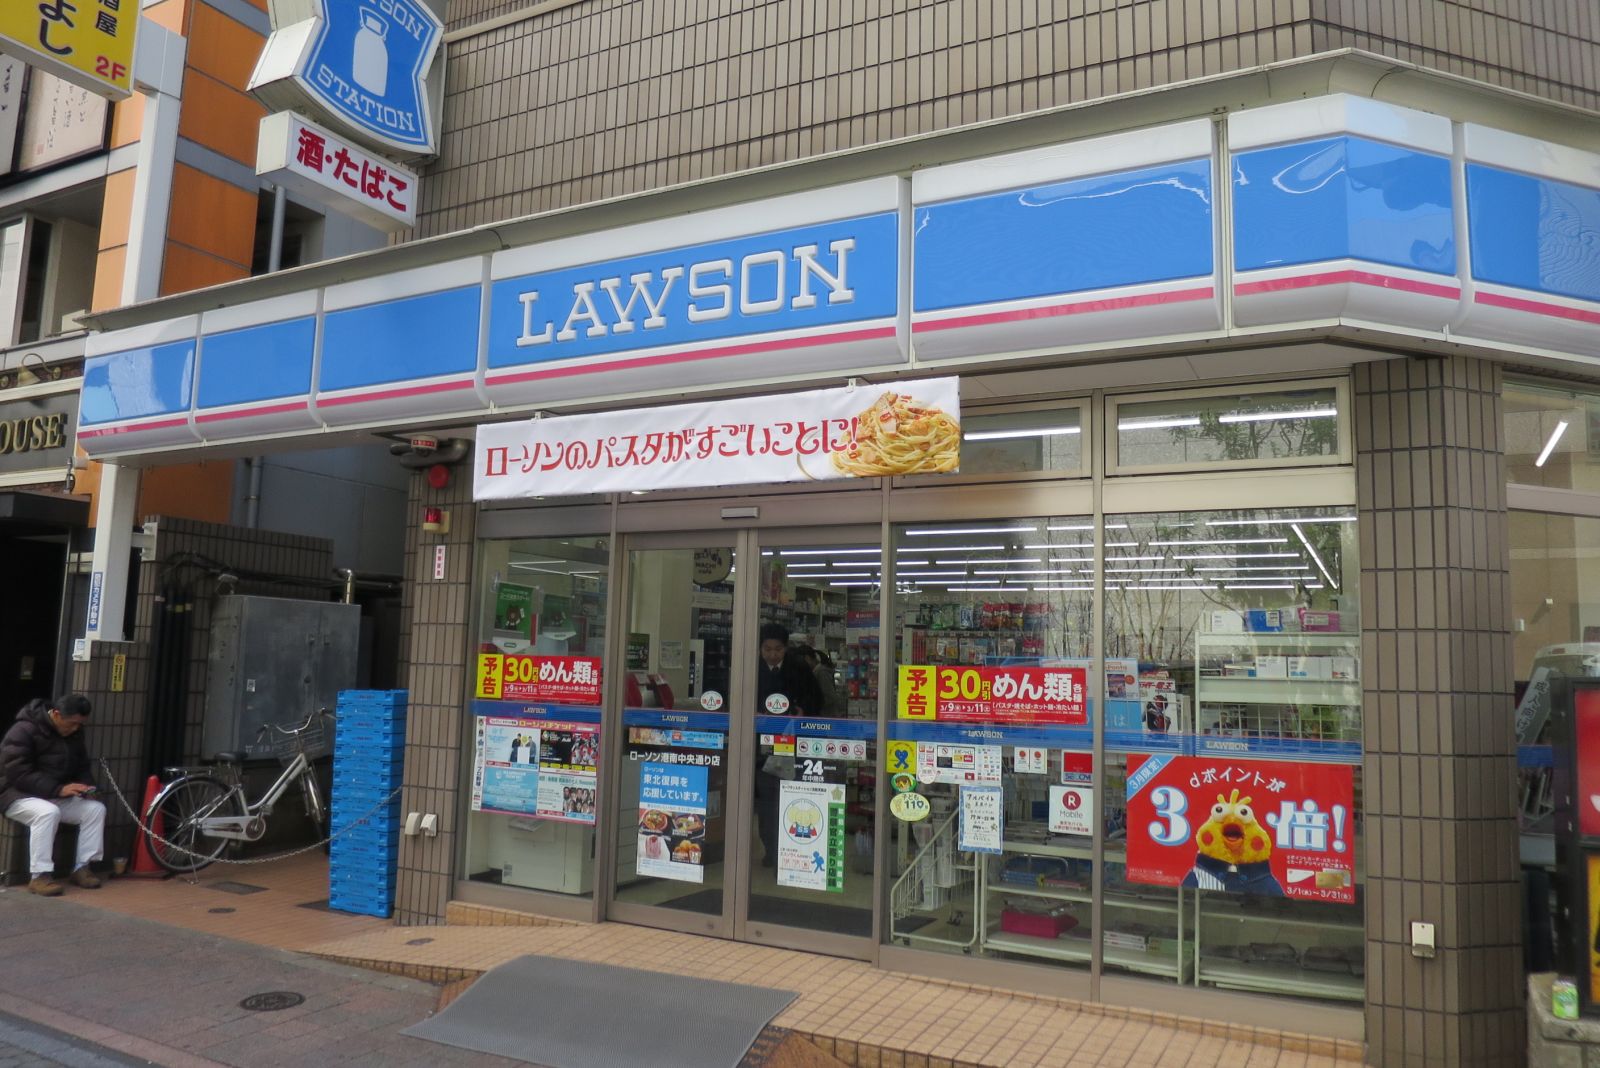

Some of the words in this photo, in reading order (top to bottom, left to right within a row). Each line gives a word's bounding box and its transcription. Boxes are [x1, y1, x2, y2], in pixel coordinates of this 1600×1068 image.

[95, 55, 127, 80] 2F
[317, 64, 416, 132] STATION
[296, 127, 408, 212] 酒・たばこ
[515, 238, 856, 347] LAWSON
[485, 416, 862, 478] ローソンのパスタがすごいことに!
[482, 657, 498, 695] 予告
[906, 669, 928, 716] 予告
[967, 730, 1004, 739] LAWSON
[1205, 740, 1249, 751] LAWSON
[629, 751, 721, 766] ローソン港南中央通り店
[803, 759, 824, 776] 24
[643, 774, 689, 787] 東北復興を
[1060, 810, 1083, 819] Mobile
[1148, 785, 1191, 847] 3
[1265, 798, 1346, 854] 倍!
